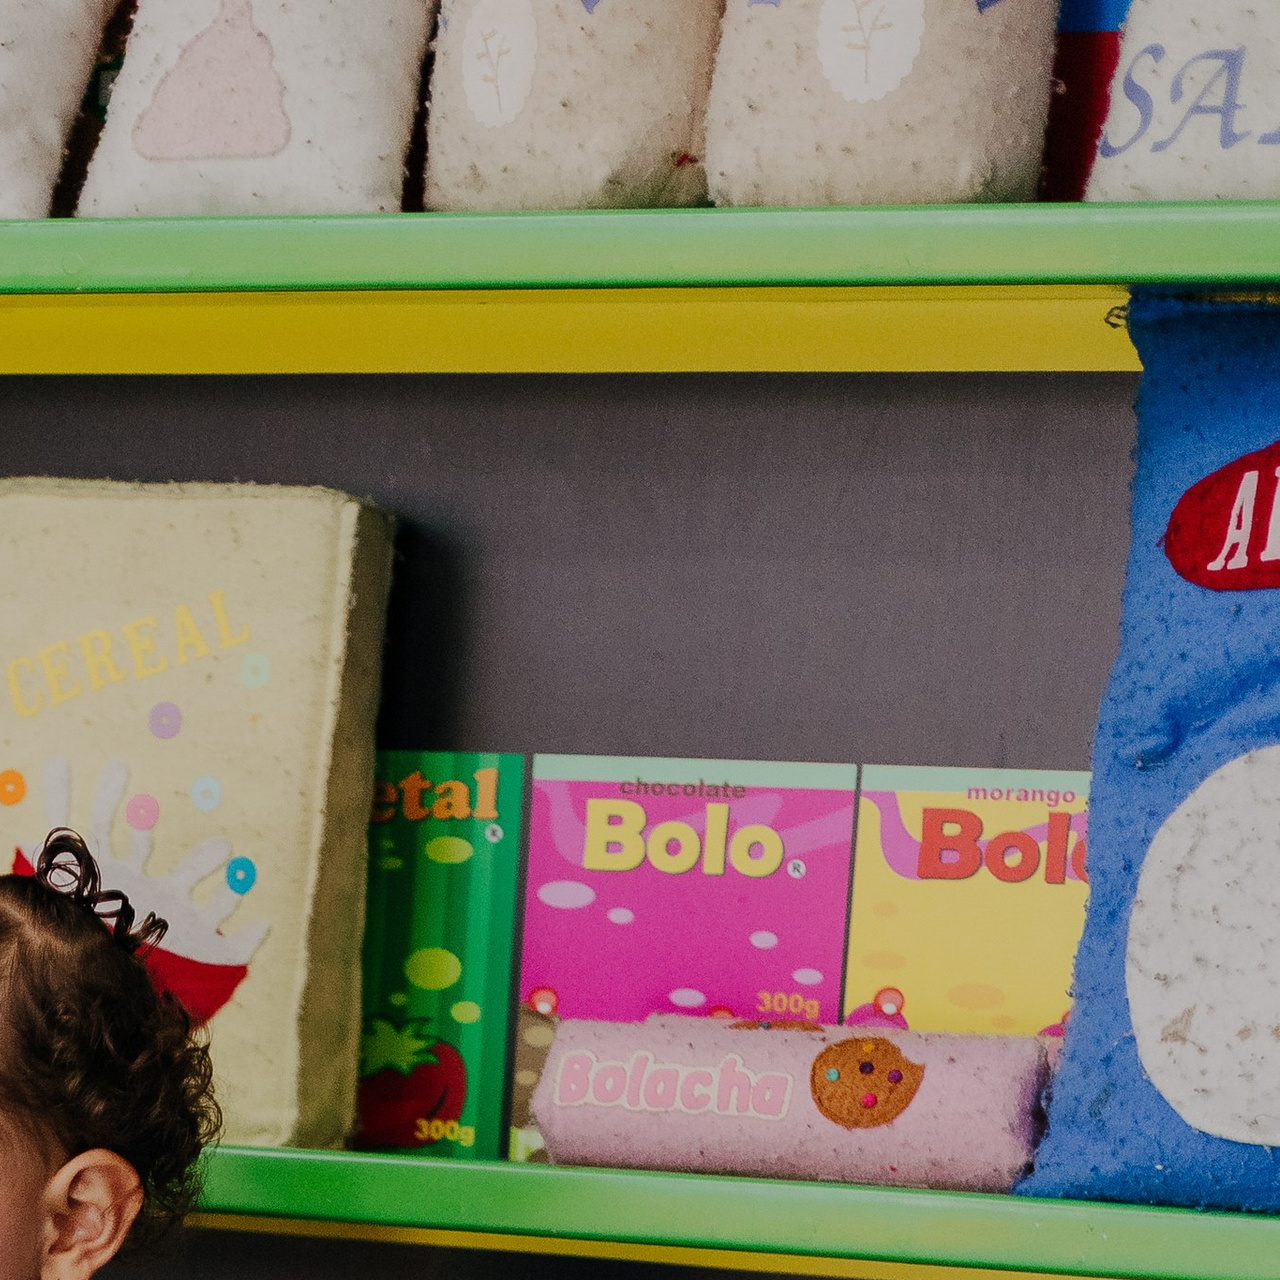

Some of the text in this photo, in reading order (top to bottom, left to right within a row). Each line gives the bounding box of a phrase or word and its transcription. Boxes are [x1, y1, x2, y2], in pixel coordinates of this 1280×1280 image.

[1099, 43, 1280, 159] SA
[4, 590, 251, 718] CEREAL
[371, 767, 499, 823] etal
[620, 777, 747, 799] chocolate
[967, 786, 1077, 808] morango
[582, 798, 785, 878] Bolo
[756, 991, 820, 1020] 300g
[554, 1050, 795, 1121] Bolacha
[413, 1118, 476, 1148] 300g
